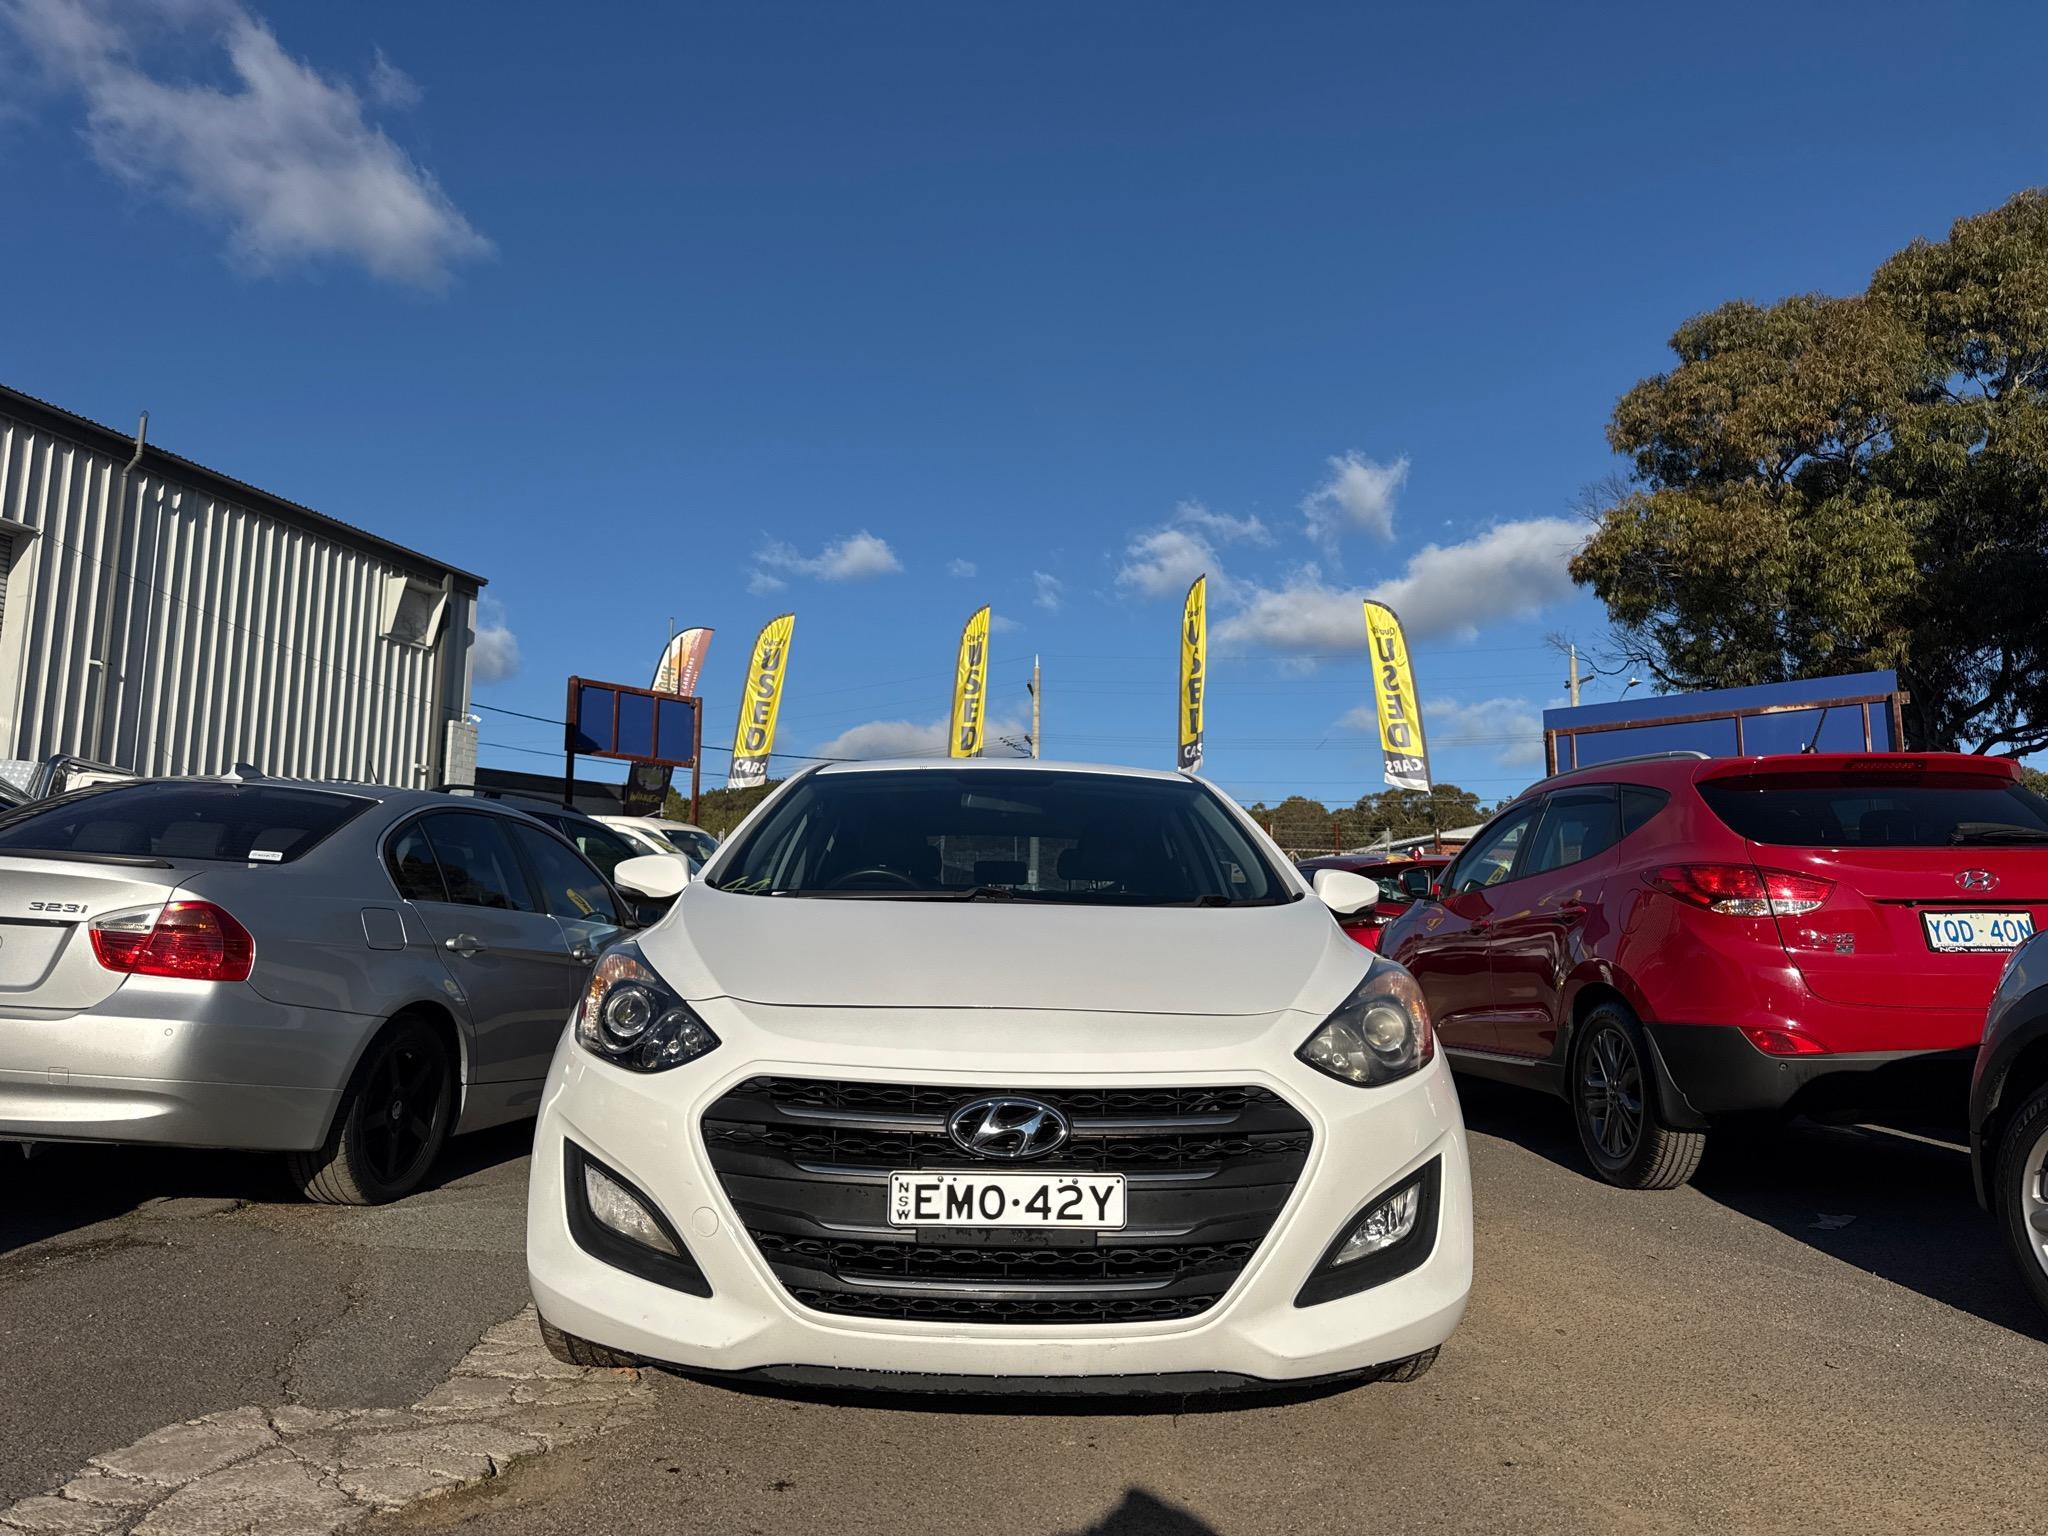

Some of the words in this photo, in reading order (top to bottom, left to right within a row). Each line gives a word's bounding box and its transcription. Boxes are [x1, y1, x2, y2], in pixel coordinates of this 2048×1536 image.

[745, 647, 780, 751] USED
[961, 641, 982, 751] USED
[735, 757, 767, 775] CARS
[897, 1182, 910, 1220] NSW
